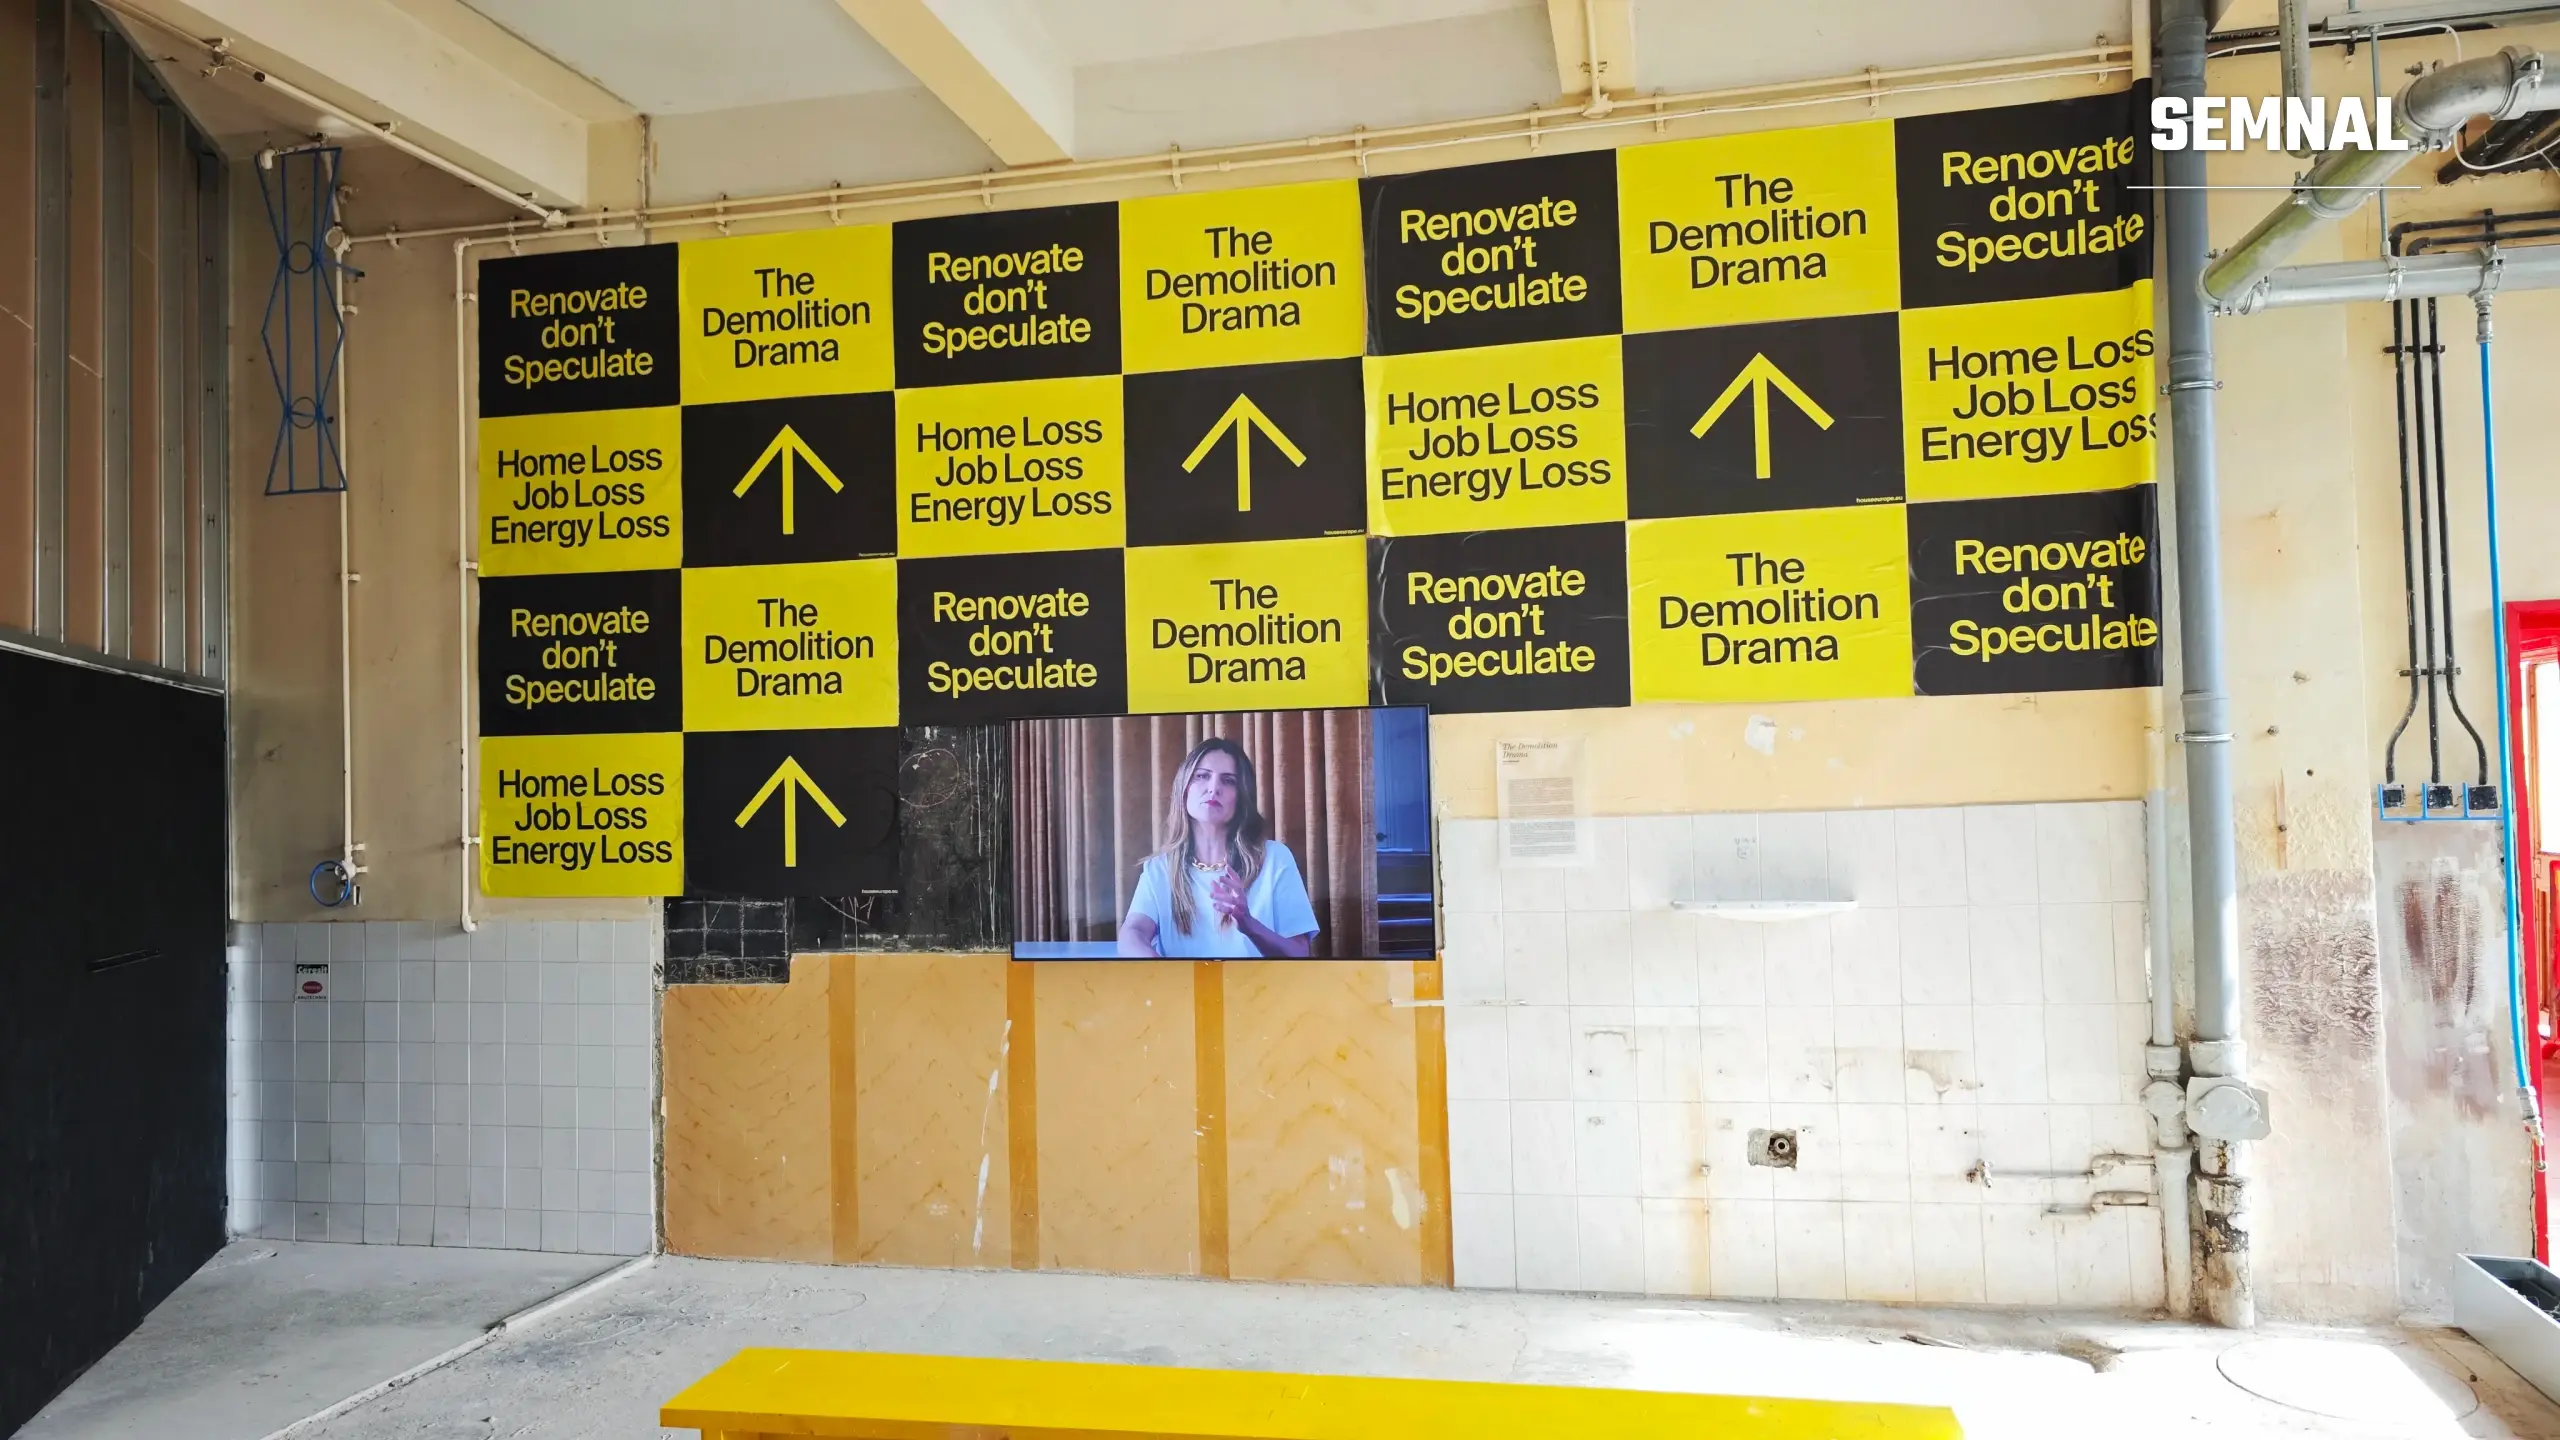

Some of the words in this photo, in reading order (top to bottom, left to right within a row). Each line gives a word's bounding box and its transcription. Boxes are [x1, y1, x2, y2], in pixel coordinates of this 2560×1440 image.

[1943, 136, 2133, 187] Renovate
[1715, 174, 1793, 208] The
[1990, 180, 2100, 222] don't
[1401, 197, 1576, 243] Renovate
[1650, 206, 1866, 254] Demolition
[1205, 227, 1272, 258] The
[1442, 236, 1537, 276] don't
[1937, 214, 2145, 272] Speculate
[929, 244, 1083, 283] Renovate
[1147, 260, 1335, 300] Demolition
[1691, 253, 1826, 288] Drama
[512, 282, 647, 318] Renovate
[755, 268, 814, 298] The
[964, 279, 1047, 315] don't
[1396, 272, 1587, 324] Speculate
[542, 316, 615, 348] don't
[704, 300, 870, 336] Demolition
[1183, 302, 1299, 333] Drama
[735, 339, 838, 368] Drama
[923, 314, 1091, 358] Speculate
[505, 349, 653, 389] Speculate
[1929, 346, 2058, 381] Home
[2068, 329, 2154, 370] Loss
[1389, 392, 1500, 425] Home
[1509, 383, 1599, 415] Loss
[1953, 382, 2034, 419] Job
[2044, 376, 2136, 412] Loss
[918, 422, 1015, 452] Home
[1023, 417, 1102, 446] Loss
[1409, 425, 1479, 460] Job
[1488, 423, 1577, 454] Loss
[1922, 426, 2072, 463] Energy
[498, 450, 585, 478] Home
[592, 445, 662, 473] Loss
[936, 455, 997, 486] Job
[1005, 453, 1083, 482] Loss
[1382, 467, 1512, 501] Energy
[1520, 458, 1610, 490] Loss
[513, 480, 568, 510] Job
[575, 479, 644, 507] Loss
[912, 493, 1025, 526] Energy
[1033, 487, 1111, 516] Loss
[492, 516, 593, 548] Energy
[599, 511, 669, 539] Loss
[1726, 553, 1804, 586] The
[1956, 531, 2146, 575] Renovate
[1210, 579, 1278, 610] The
[1408, 566, 1585, 604] Renovate
[2003, 573, 2114, 613] don't
[512, 606, 649, 637] Renovate
[758, 599, 817, 627] The
[934, 588, 1089, 622] Renovate
[1449, 603, 1544, 640] don't
[1660, 588, 1878, 629] Demolition
[705, 632, 873, 664] Demolition
[969, 623, 1053, 656] don't
[1153, 613, 1340, 648] Demolition
[1949, 614, 2158, 662] Speculate
[543, 639, 617, 669] don't
[1403, 641, 1595, 684] Speculate
[1702, 633, 1838, 665] Drama
[737, 668, 842, 696] Drama
[928, 658, 1097, 698] Speculate
[1188, 653, 1305, 683] Drama
[506, 672, 655, 709] Speculate
[499, 769, 587, 798] Home
[594, 768, 664, 796] Loss
[515, 802, 570, 831] Job
[576, 802, 647, 830] Loss
[493, 836, 595, 871] Energy
[602, 835, 672, 863] Loss
